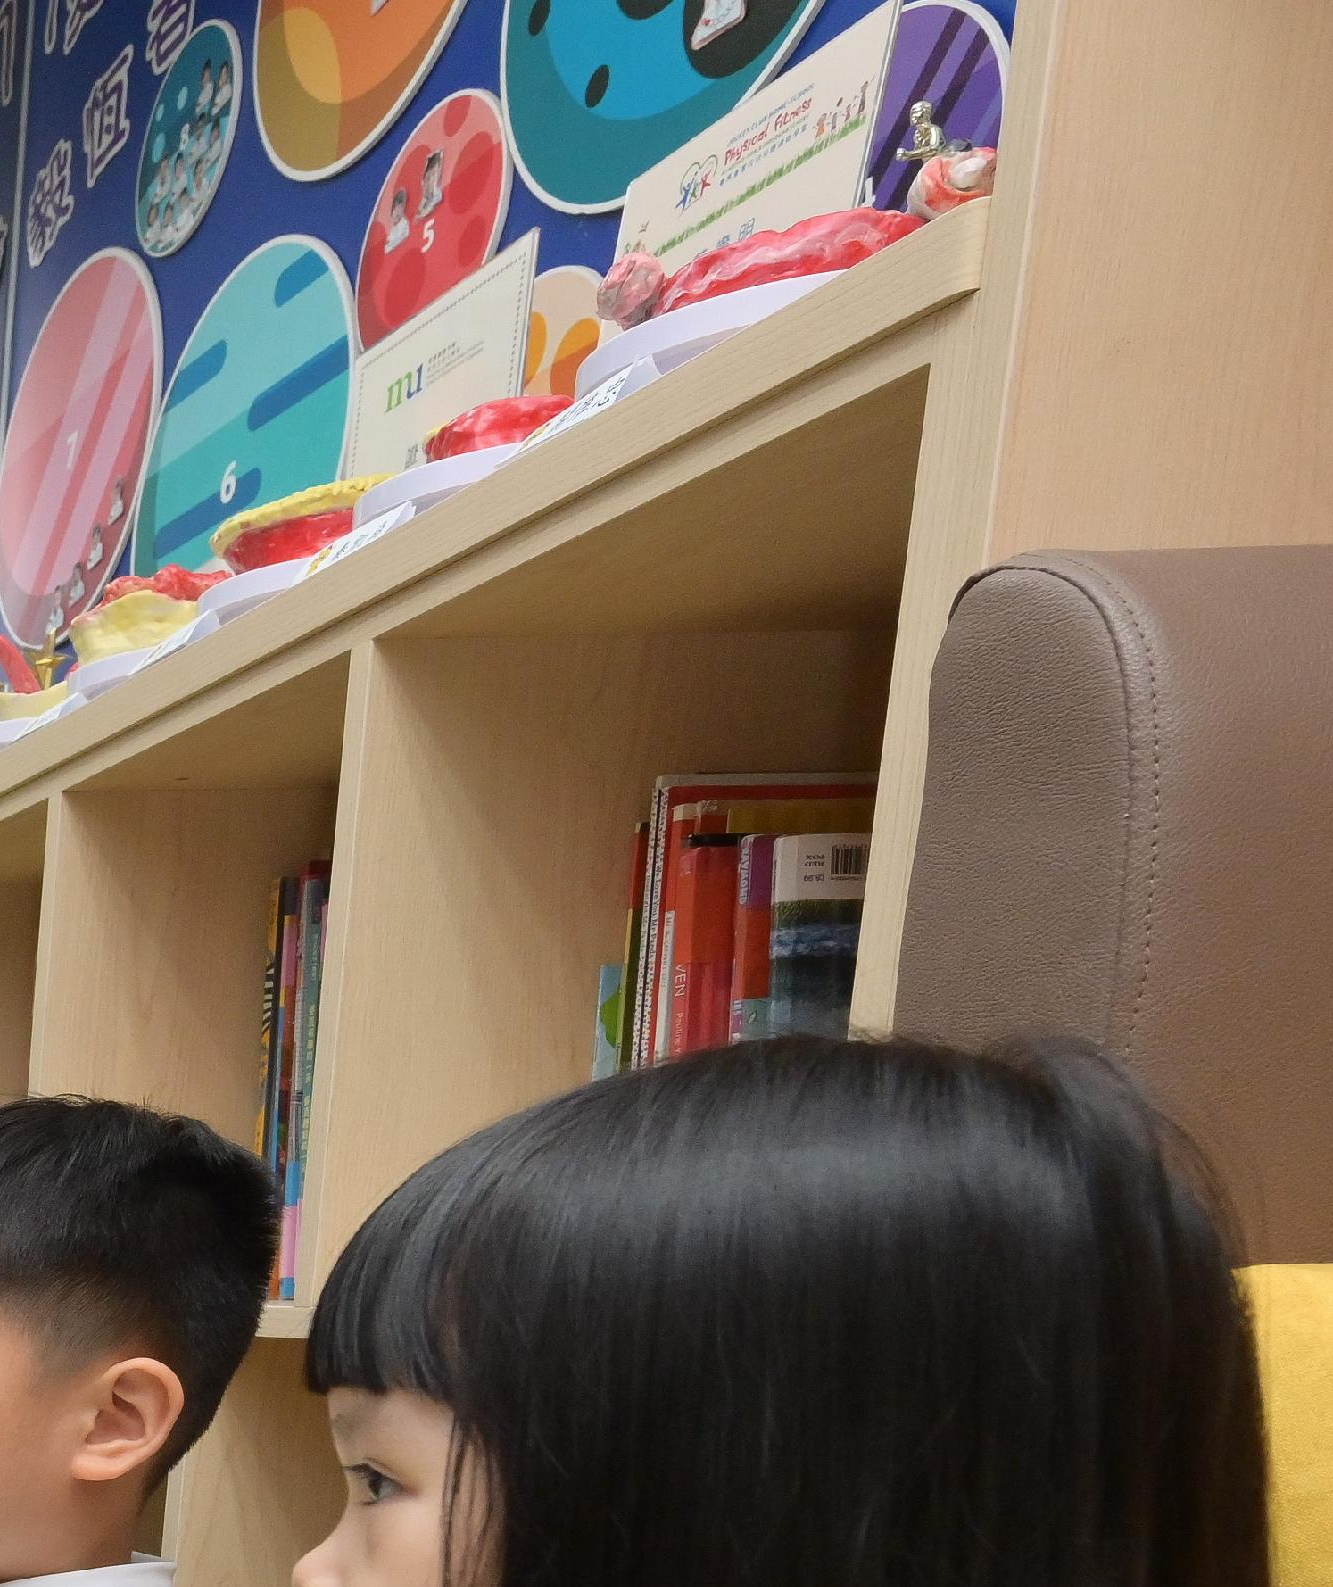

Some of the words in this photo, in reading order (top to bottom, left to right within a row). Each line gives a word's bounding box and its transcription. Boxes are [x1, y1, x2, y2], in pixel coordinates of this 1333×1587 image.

[724, 122, 770, 166] Physical
[774, 97, 812, 132] Fitness
[421, 218, 436, 255] 5
[65, 432, 77, 470] 1
[219, 459, 239, 505] 6
